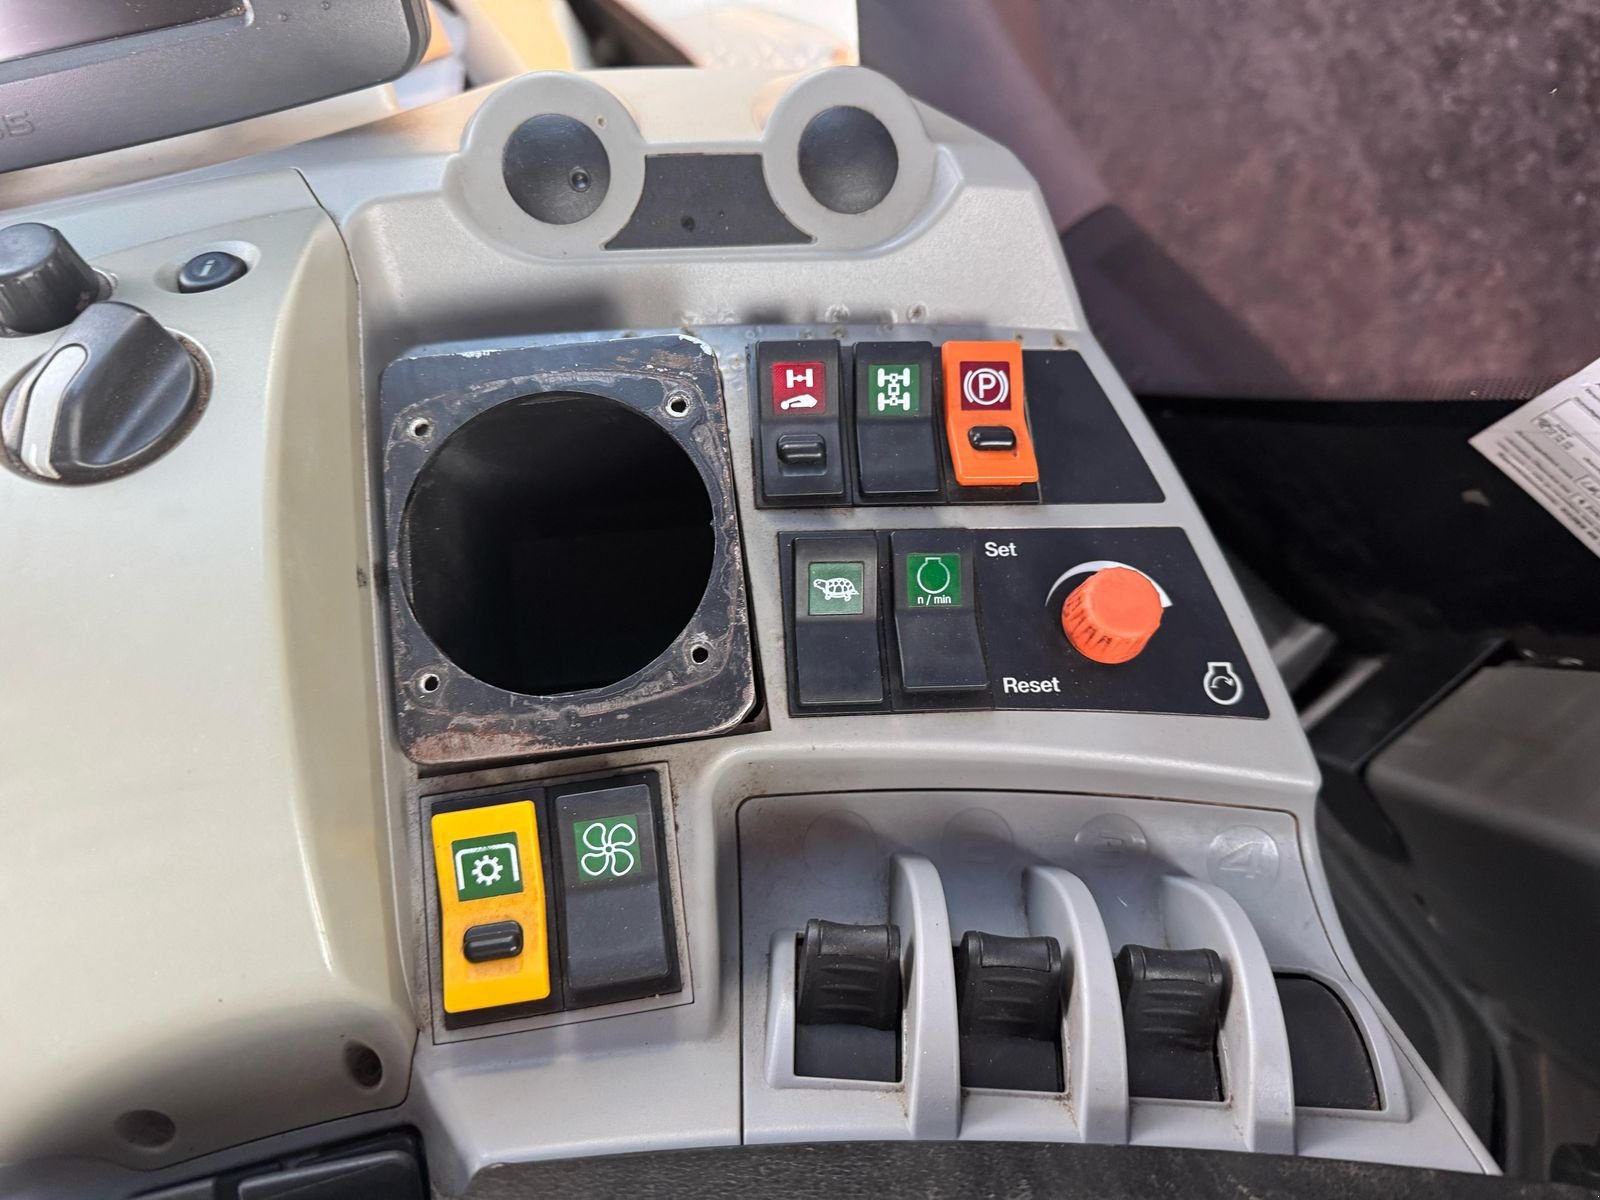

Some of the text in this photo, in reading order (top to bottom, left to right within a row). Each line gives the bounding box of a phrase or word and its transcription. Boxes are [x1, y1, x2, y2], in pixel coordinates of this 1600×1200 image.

[978, 373, 997, 399] P
[984, 541, 1018, 557] Set
[917, 594, 952, 606] n / min
[1002, 677, 1061, 694] Reset
[1217, 841, 1264, 881] 4
